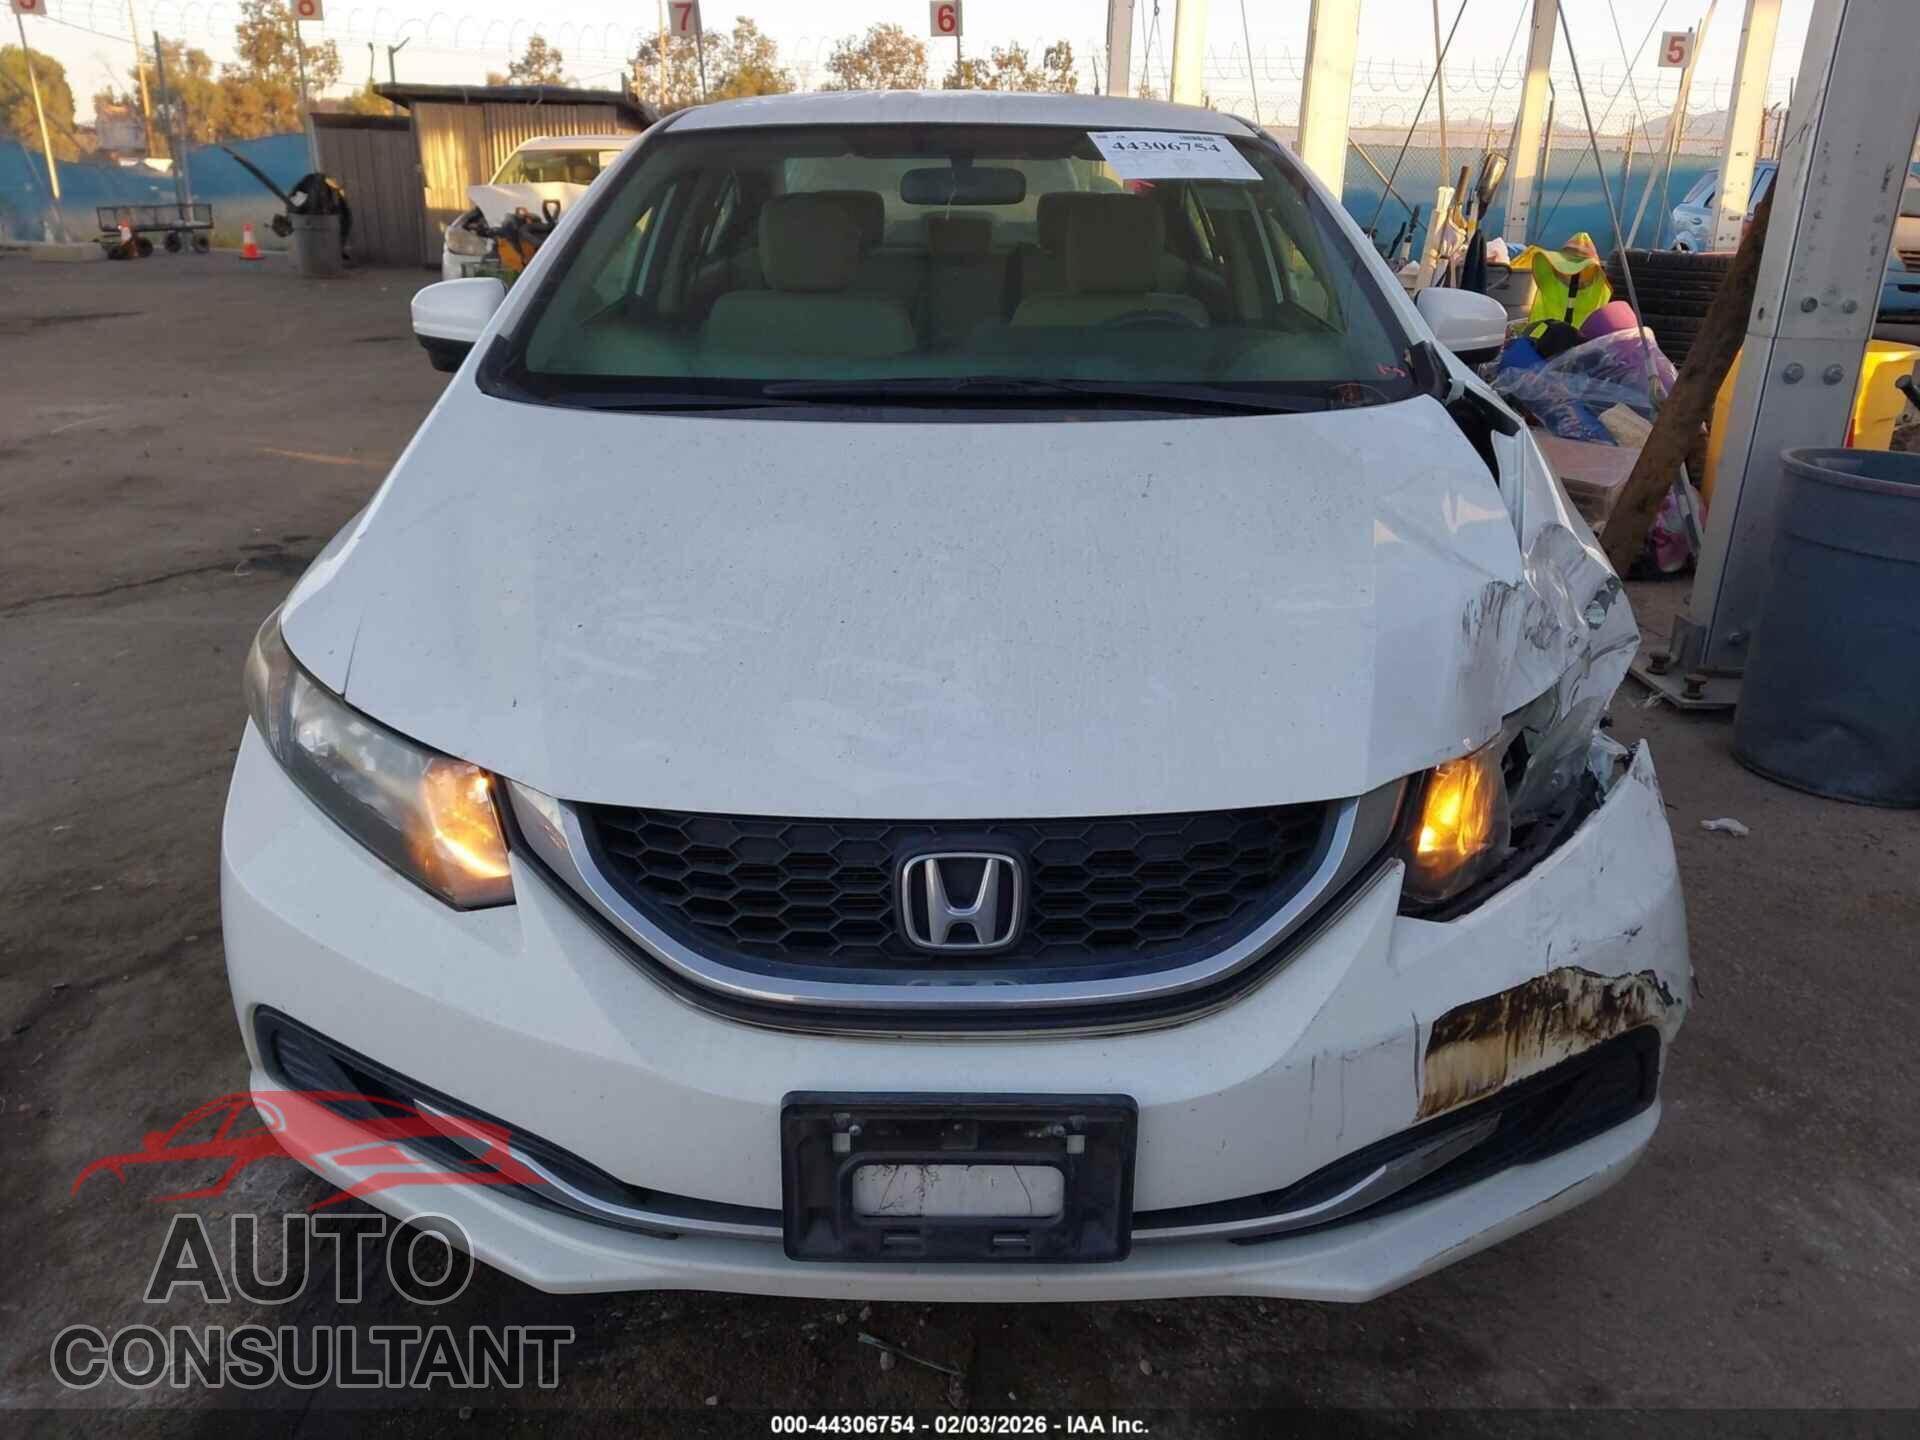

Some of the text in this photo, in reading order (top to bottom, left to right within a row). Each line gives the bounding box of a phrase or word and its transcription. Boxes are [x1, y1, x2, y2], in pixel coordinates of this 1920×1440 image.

[672, 3, 692, 31] 7
[938, 4, 956, 32] 6
[1667, 36, 1686, 63] 5
[1112, 140, 1221, 153] 44306754
